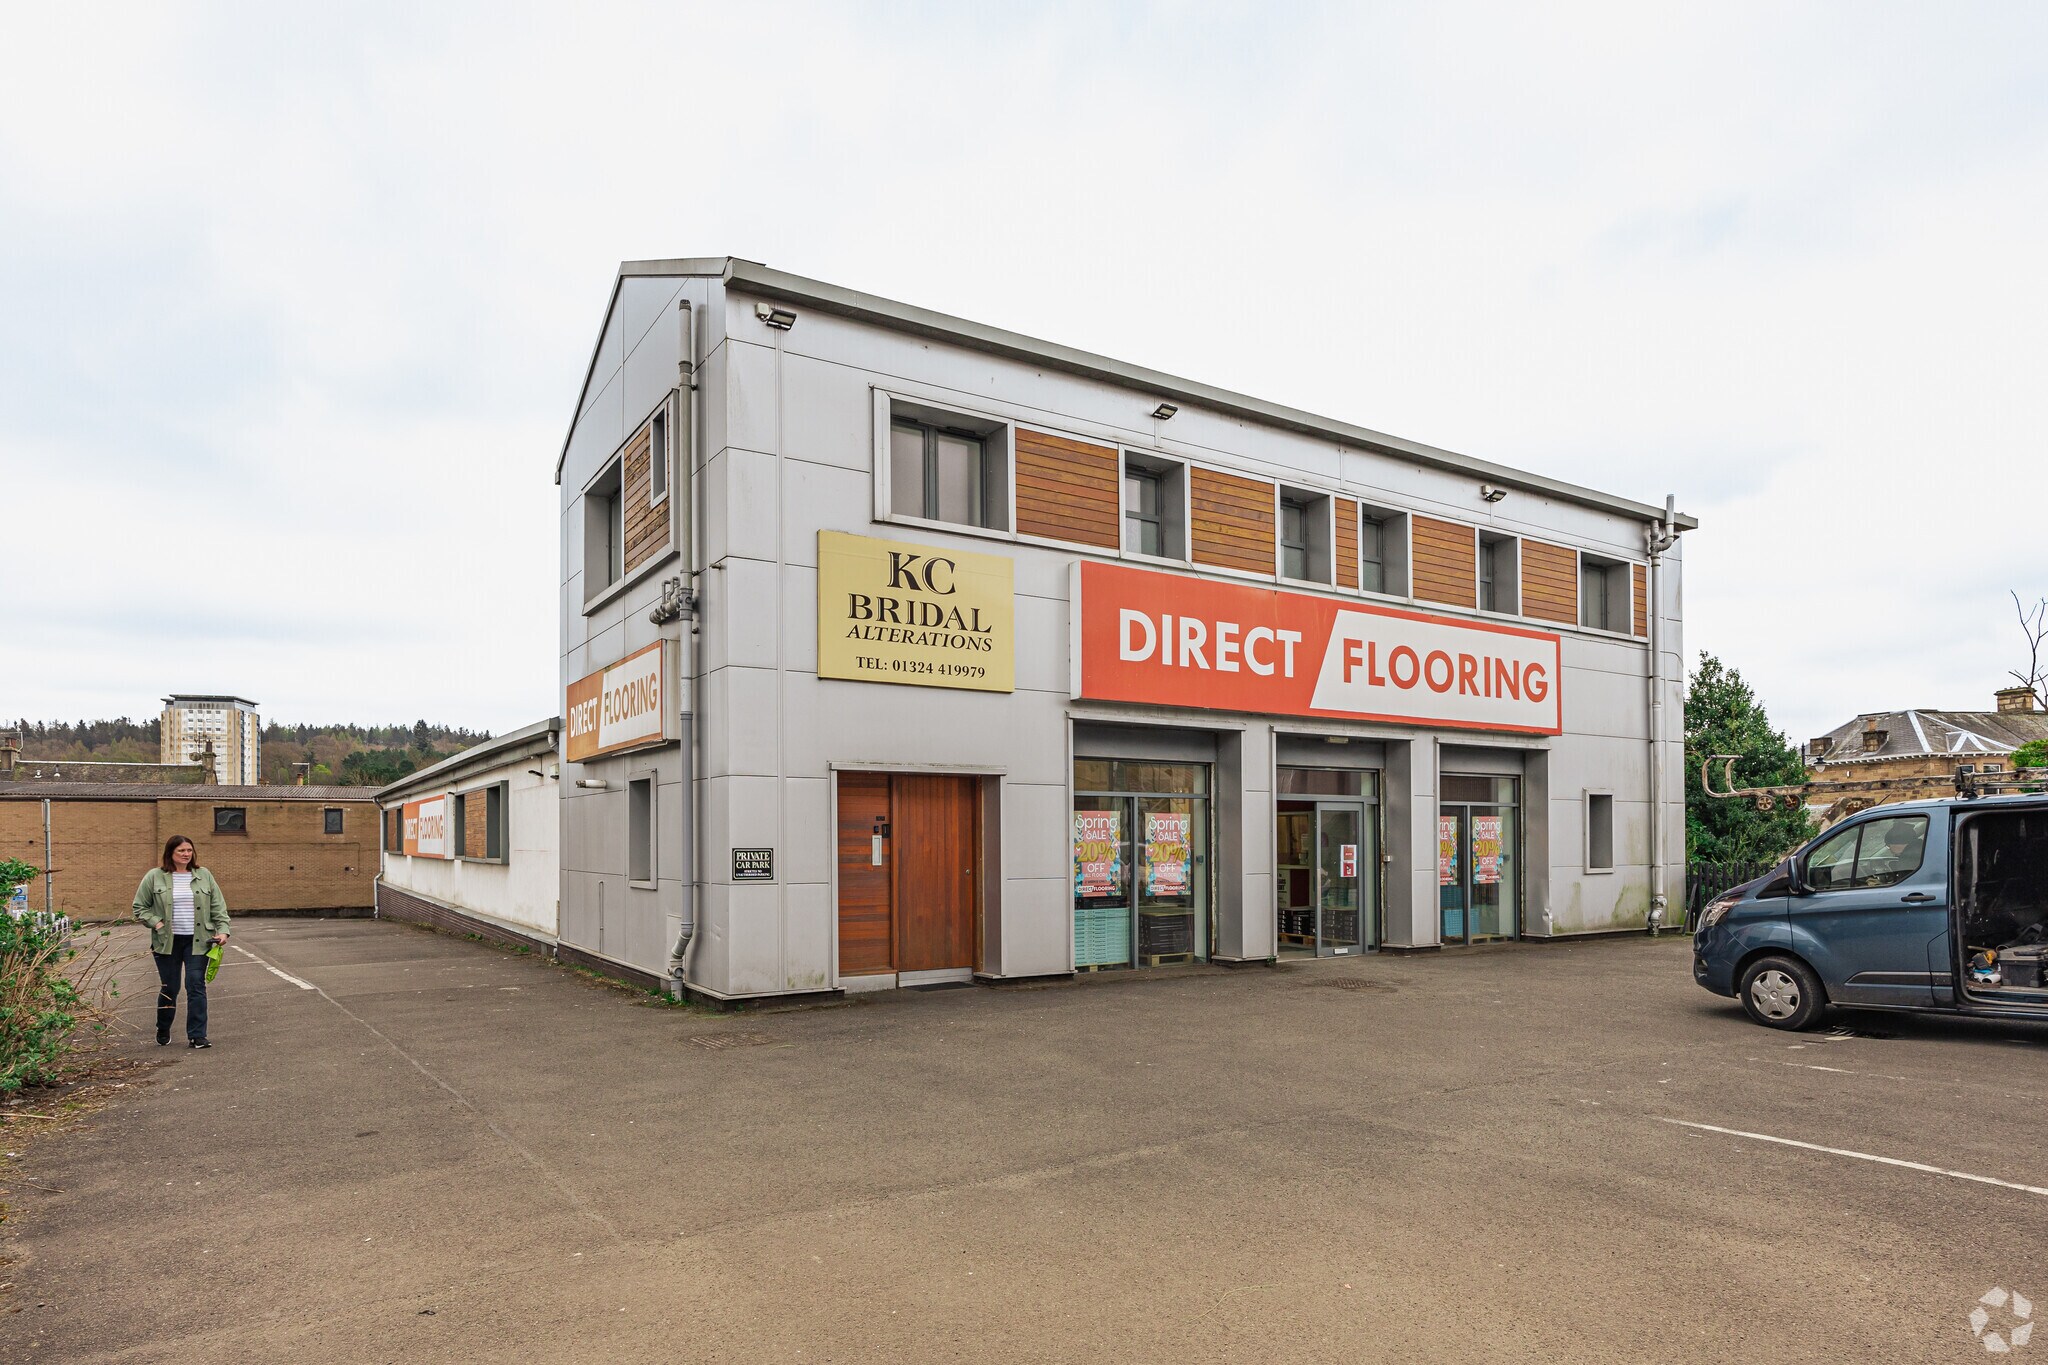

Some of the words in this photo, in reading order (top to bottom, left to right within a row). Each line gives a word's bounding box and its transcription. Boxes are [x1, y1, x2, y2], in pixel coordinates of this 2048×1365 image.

[887, 551, 956, 595] KC
[848, 593, 993, 634] BRIDAL
[845, 624, 993, 652] ALTERATIONS
[1119, 607, 1302, 678] DIRECT
[1343, 637, 1548, 703] FLOORING
[856, 656, 888, 671] TEL:
[892, 659, 934, 675] 01324
[938, 663, 986, 679] 419979
[570, 696, 598, 738] DIRECT
[604, 672, 658, 727] FLOORING
[1075, 814, 1118, 833] Spring
[1149, 816, 1188, 835] Spring
[1474, 819, 1501, 834] Spring
[1086, 830, 1107, 840] SALE
[1158, 832, 1178, 841] SALE
[1481, 831, 1495, 839] SALE
[736, 851, 770, 861] PRIVATE
[1076, 841, 1117, 863] 20%
[1149, 842, 1188, 863] 20%
[1475, 840, 1500, 857] 20%
[736, 861, 751, 869] CAR
[752, 861, 770, 869] PARK
[1087, 863, 1106, 873] OFF
[1159, 863, 1177, 873] OFF
[1481, 857, 1495, 865] OFF
